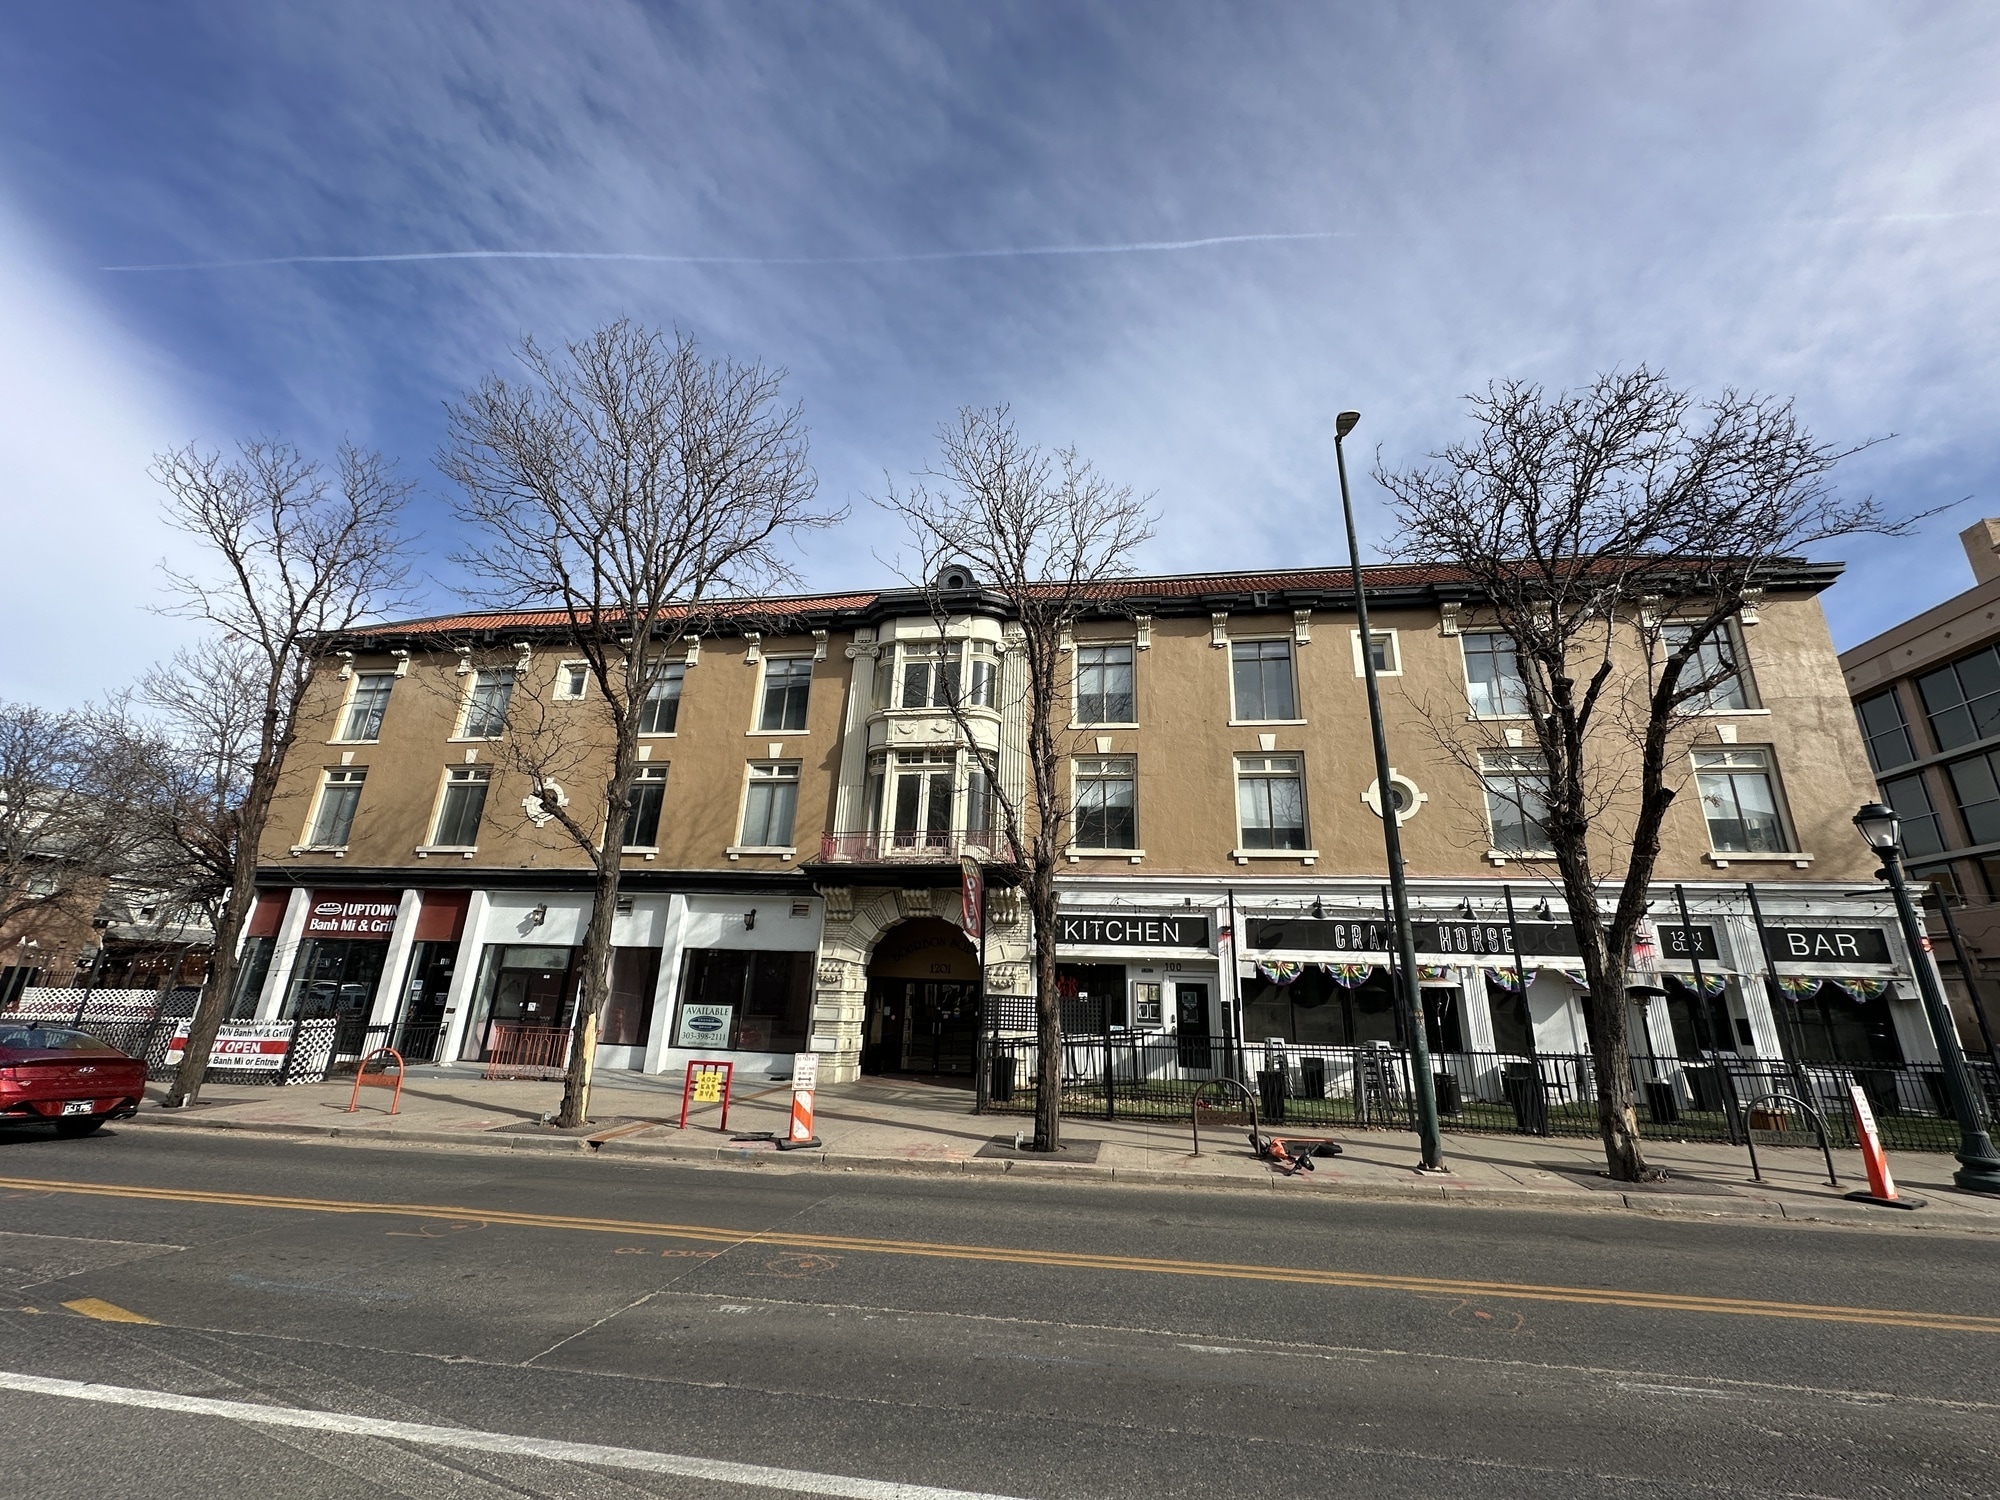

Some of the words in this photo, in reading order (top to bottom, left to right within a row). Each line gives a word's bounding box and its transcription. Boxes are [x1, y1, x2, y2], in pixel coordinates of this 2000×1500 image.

[966, 877, 977, 930] OPEN
[348, 904, 398, 916] UPTOWN
[309, 918, 339, 931] Banh
[340, 919, 357, 931] Mi
[358, 919, 368, 932] &
[1064, 920, 1180, 943] KITCHEN
[1670, 931, 1702, 941] 121
[1438, 926, 1515, 953] HORSE
[1787, 933, 1860, 957] BAR
[890, 937, 946, 963] BOURBON
[930, 963, 952, 974] 1201
[1165, 962, 1182, 972] 100
[686, 1006, 730, 1016] AVAILABLE
[233, 1028, 252, 1038] Banh
[264, 1028, 270, 1038] &
[272, 1028, 294, 1038] Grill
[682, 1031, 726, 1041] 303-398-2111
[225, 1041, 261, 1053] OPEN
[213, 1056, 232, 1065] Banh
[234, 1057, 244, 1065] Mi
[245, 1058, 254, 1066] or
[255, 1057, 279, 1067] Entree
